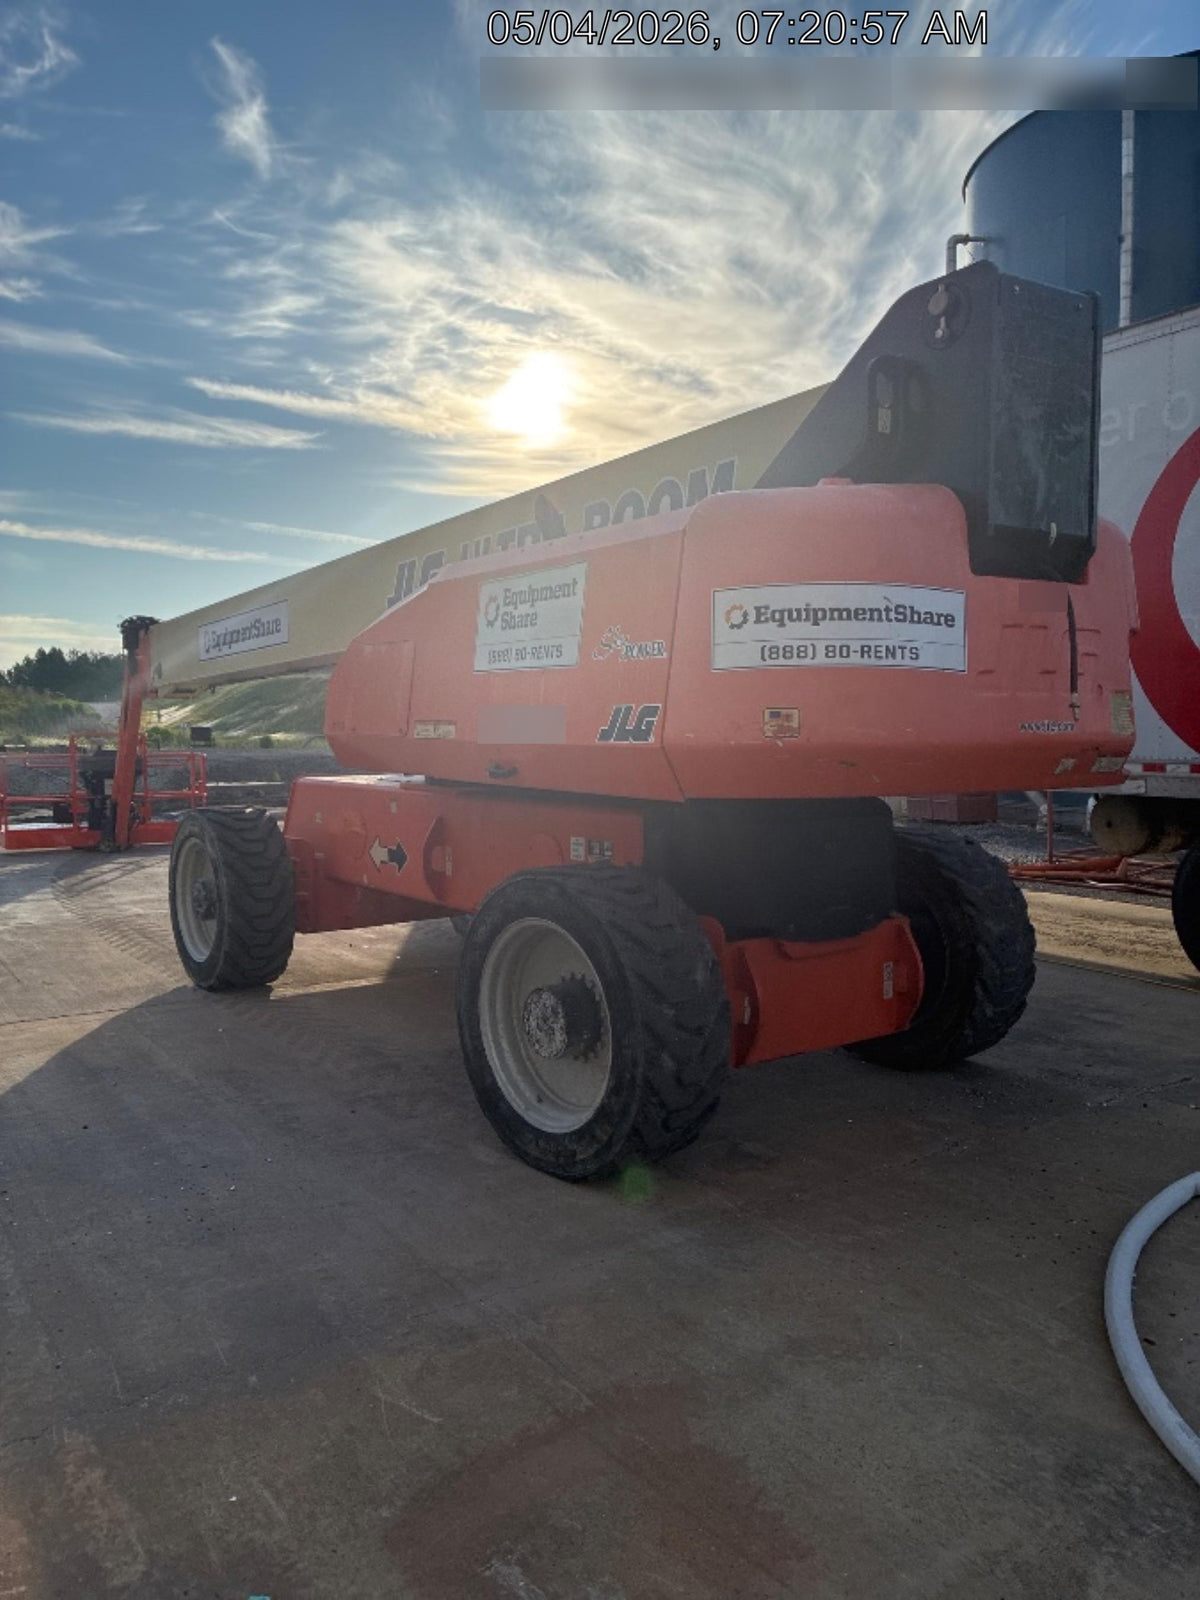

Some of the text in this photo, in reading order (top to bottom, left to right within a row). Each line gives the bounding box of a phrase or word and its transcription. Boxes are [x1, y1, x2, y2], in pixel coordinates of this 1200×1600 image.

[503, 578, 578, 609] Equipment
[500, 611, 538, 631] Share
[754, 603, 956, 628] EquipmentShare
[760, 644, 920, 662] (888) 80-RENTS
[596, 704, 662, 743] JLG
